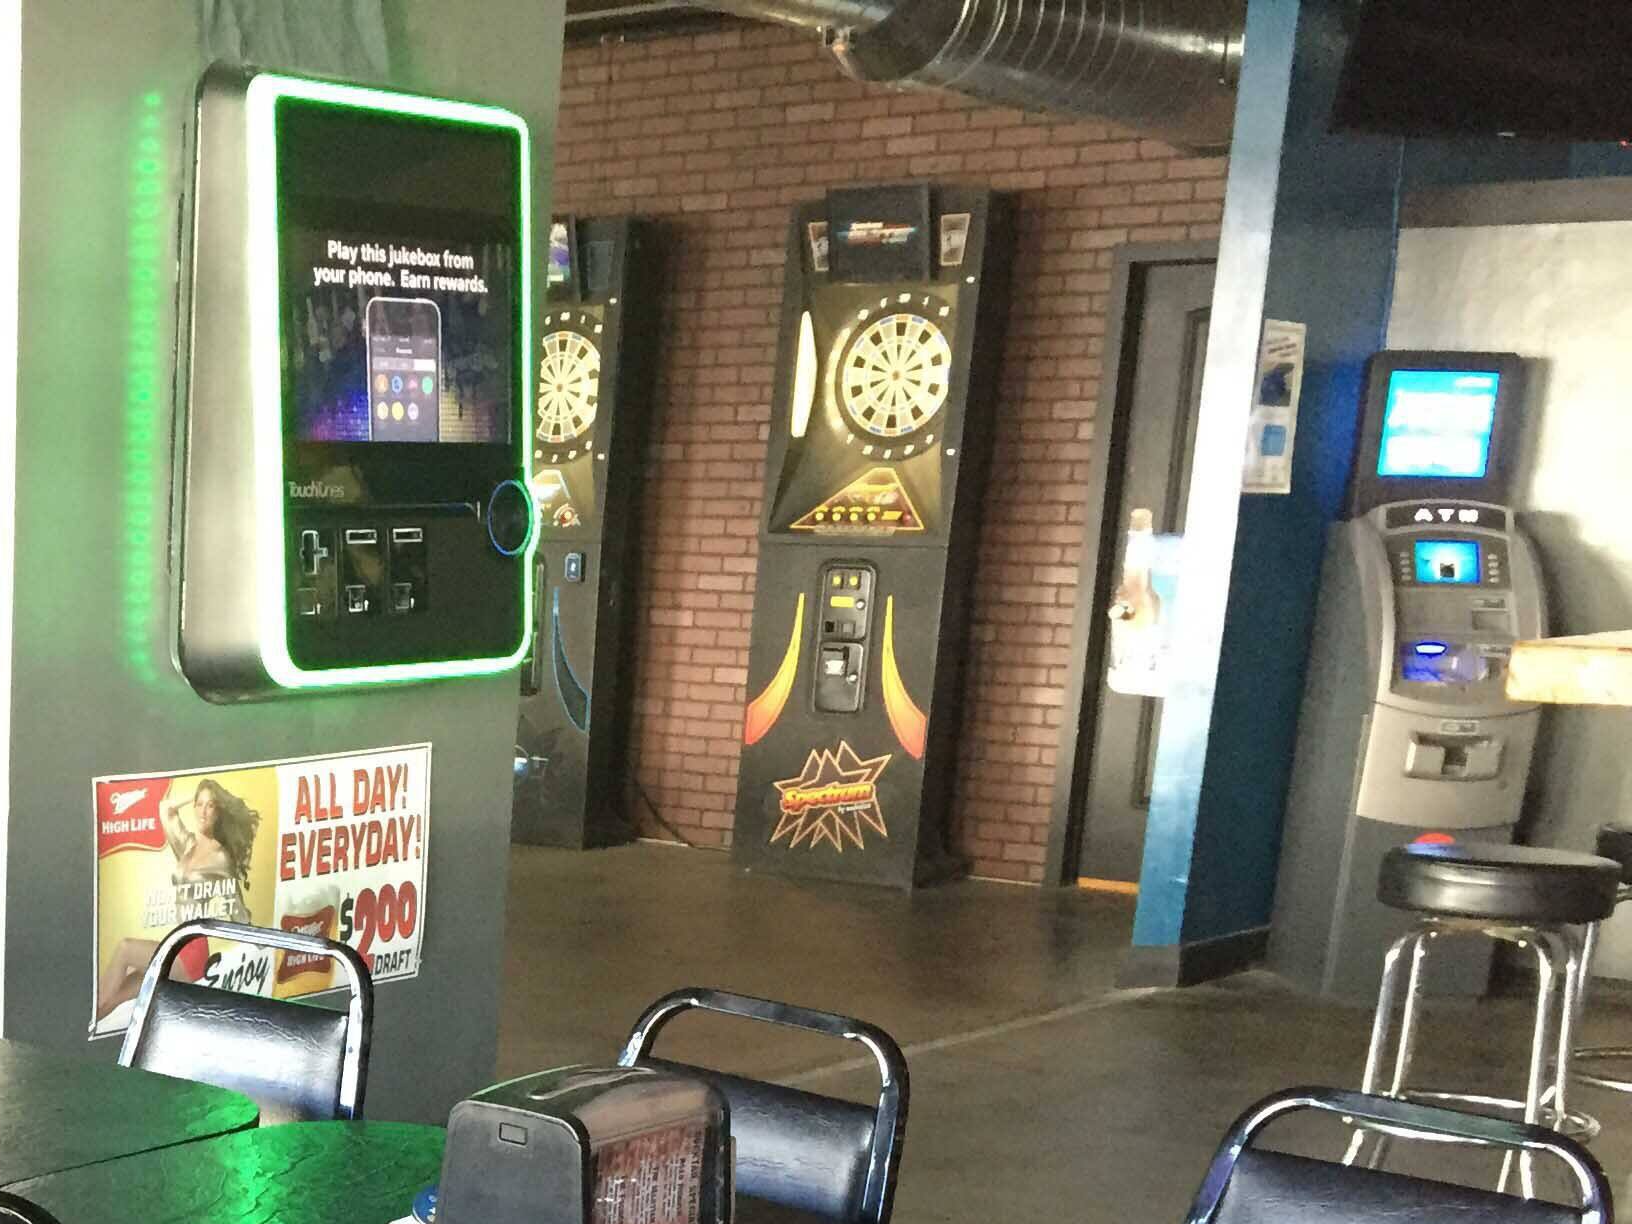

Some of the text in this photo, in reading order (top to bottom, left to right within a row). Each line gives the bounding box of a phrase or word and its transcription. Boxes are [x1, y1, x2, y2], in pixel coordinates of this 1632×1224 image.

[327, 239, 474, 270] Play this jukebox from
[313, 266, 489, 294] your phone. Earn rewards.
[1414, 508, 1479, 523] ATM
[294, 763, 409, 825] ALL DAY!
[783, 783, 873, 812] Spectrum
[101, 818, 156, 835] HIGH LIFE
[280, 813, 422, 882] EVERYDAY!
[193, 877, 237, 900] DRAIN
[143, 898, 240, 929] YOUR WALLET.
[203, 951, 269, 996] Enjoy
[374, 948, 412, 976] DRAFT
